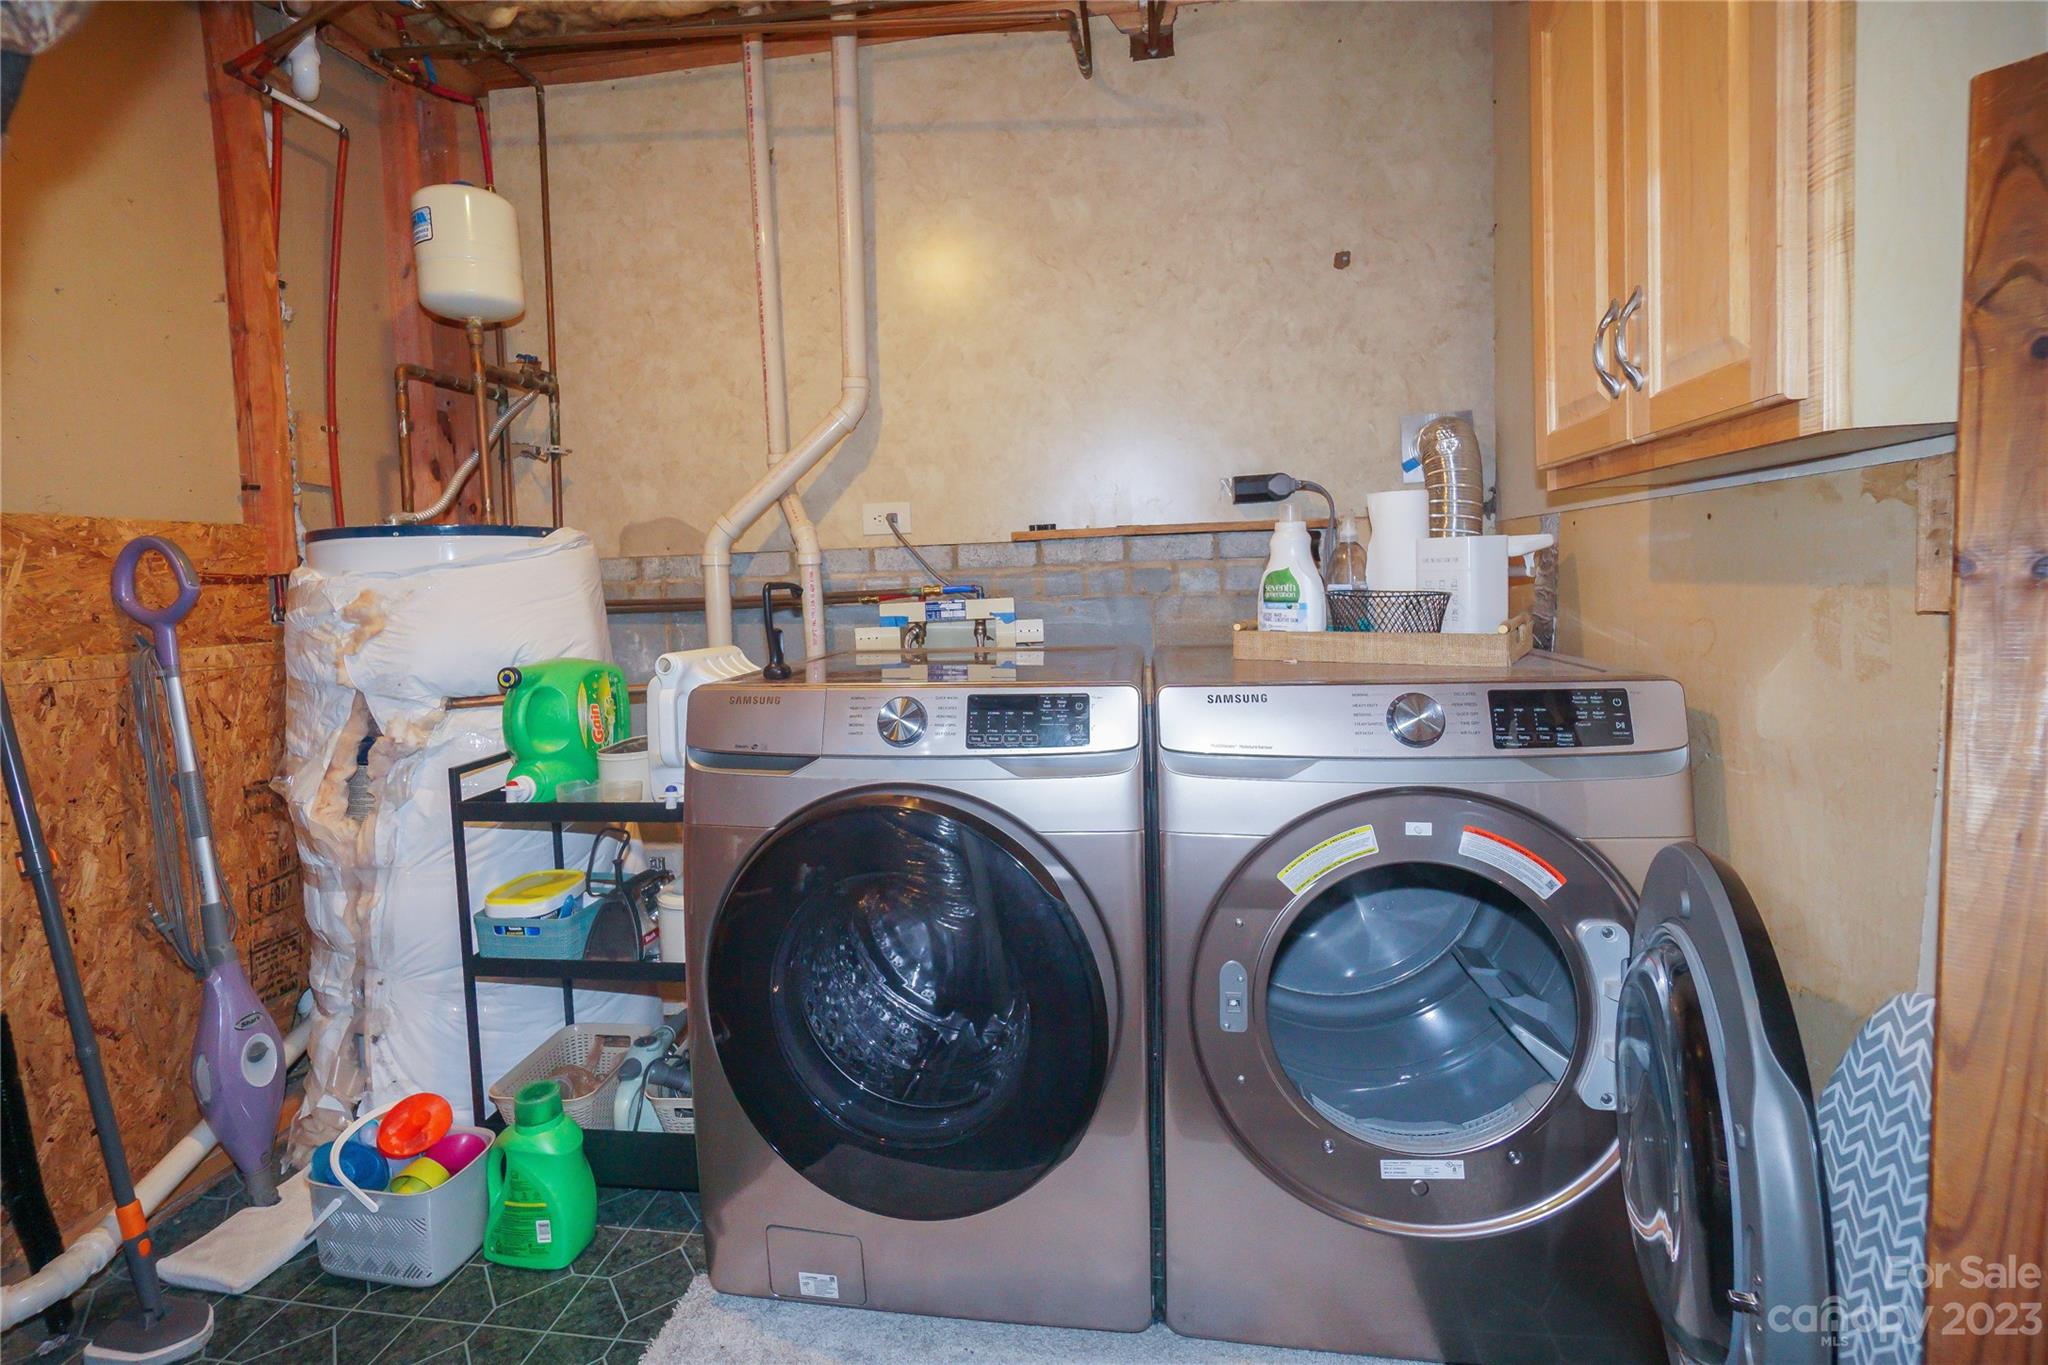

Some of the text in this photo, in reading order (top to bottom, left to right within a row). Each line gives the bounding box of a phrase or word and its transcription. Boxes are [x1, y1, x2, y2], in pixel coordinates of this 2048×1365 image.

[1264, 583, 1296, 592] seventh
[729, 696, 781, 705] SAMSUNG
[1207, 693, 1268, 704] SAMSUNG
[589, 703, 605, 744] Gain
